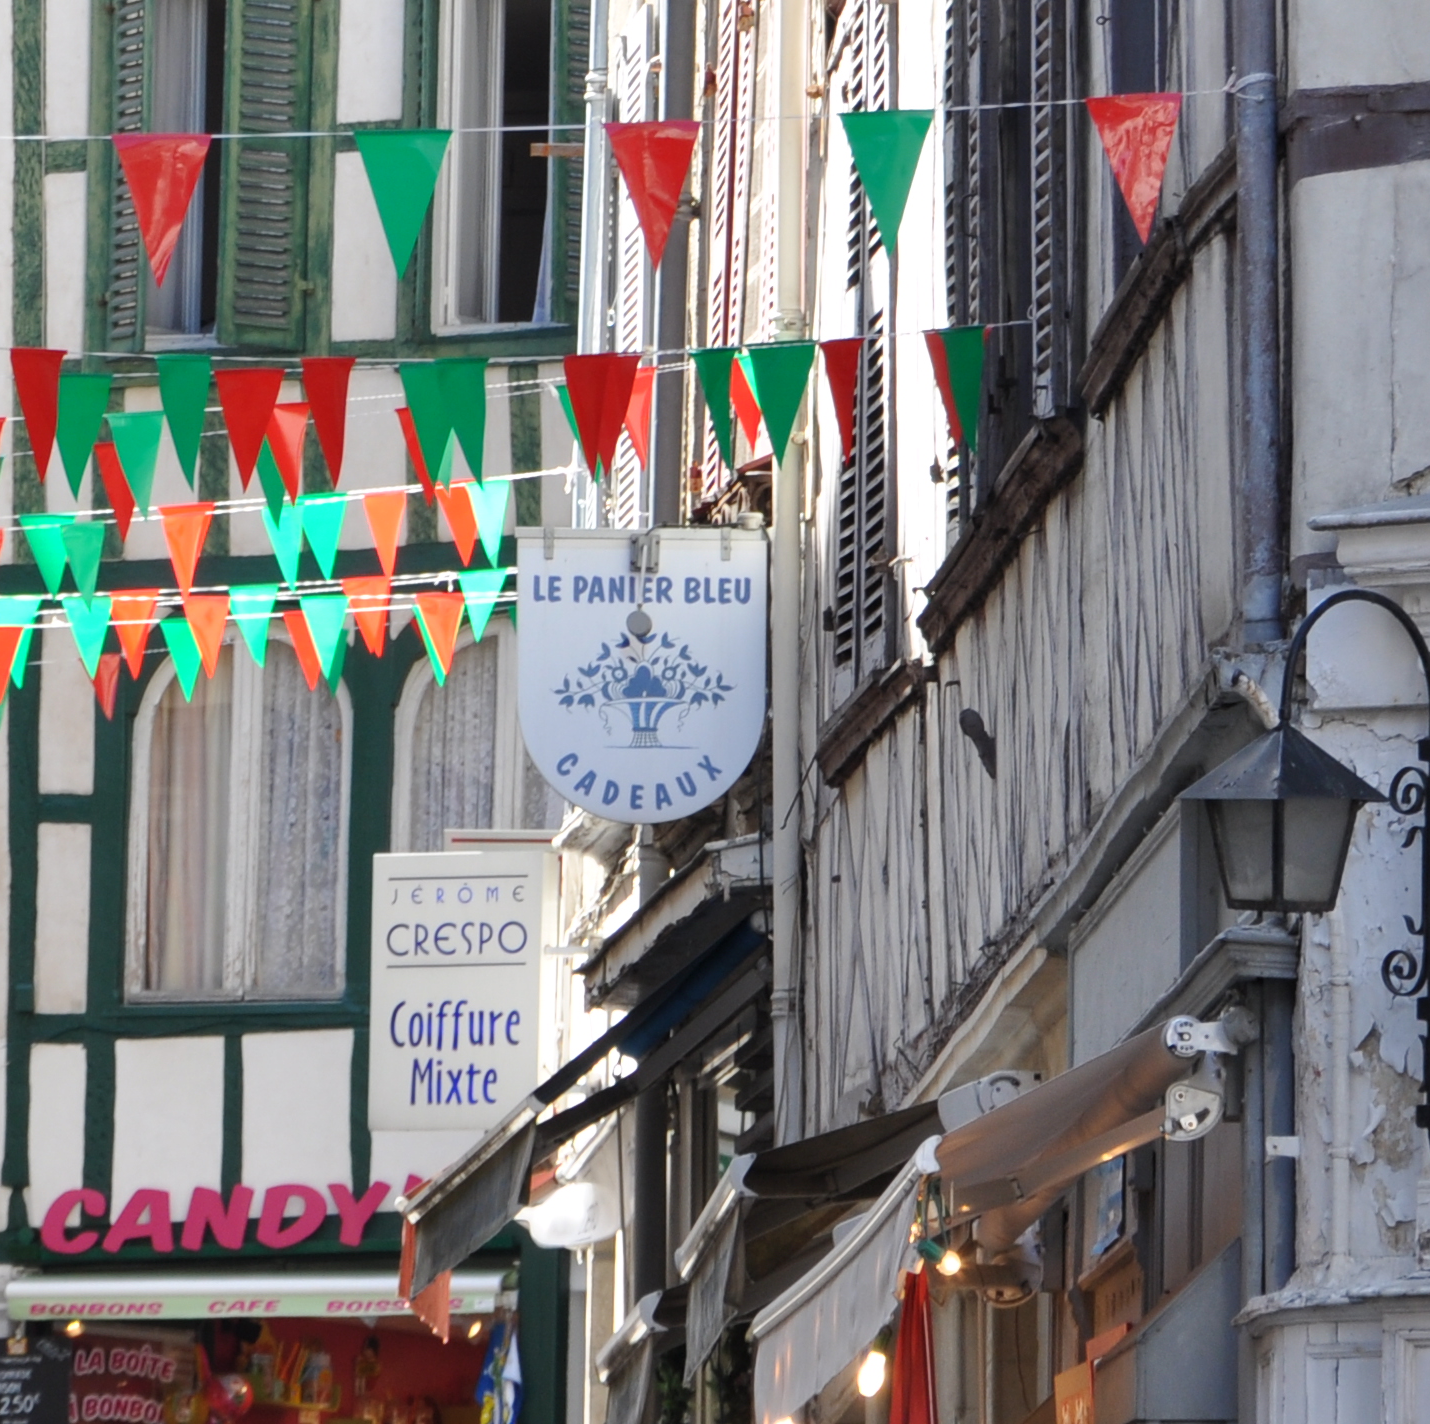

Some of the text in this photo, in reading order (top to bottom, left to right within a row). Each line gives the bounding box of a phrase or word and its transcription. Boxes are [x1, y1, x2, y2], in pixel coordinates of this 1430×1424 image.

[533, 574, 752, 605] LE PANIER BLEU
[556, 752, 723, 811] CADEAUX
[391, 882, 525, 905] JÉRÔME
[386, 920, 528, 957] CRESPO
[390, 999, 521, 1051] Coiffure
[410, 1057, 498, 1106] Mixte
[29, 1298, 464, 1316] BONBONS CAFE BOISSS
[74, 1348, 105, 1376] LA
[109, 1344, 177, 1383] BOÎTE
